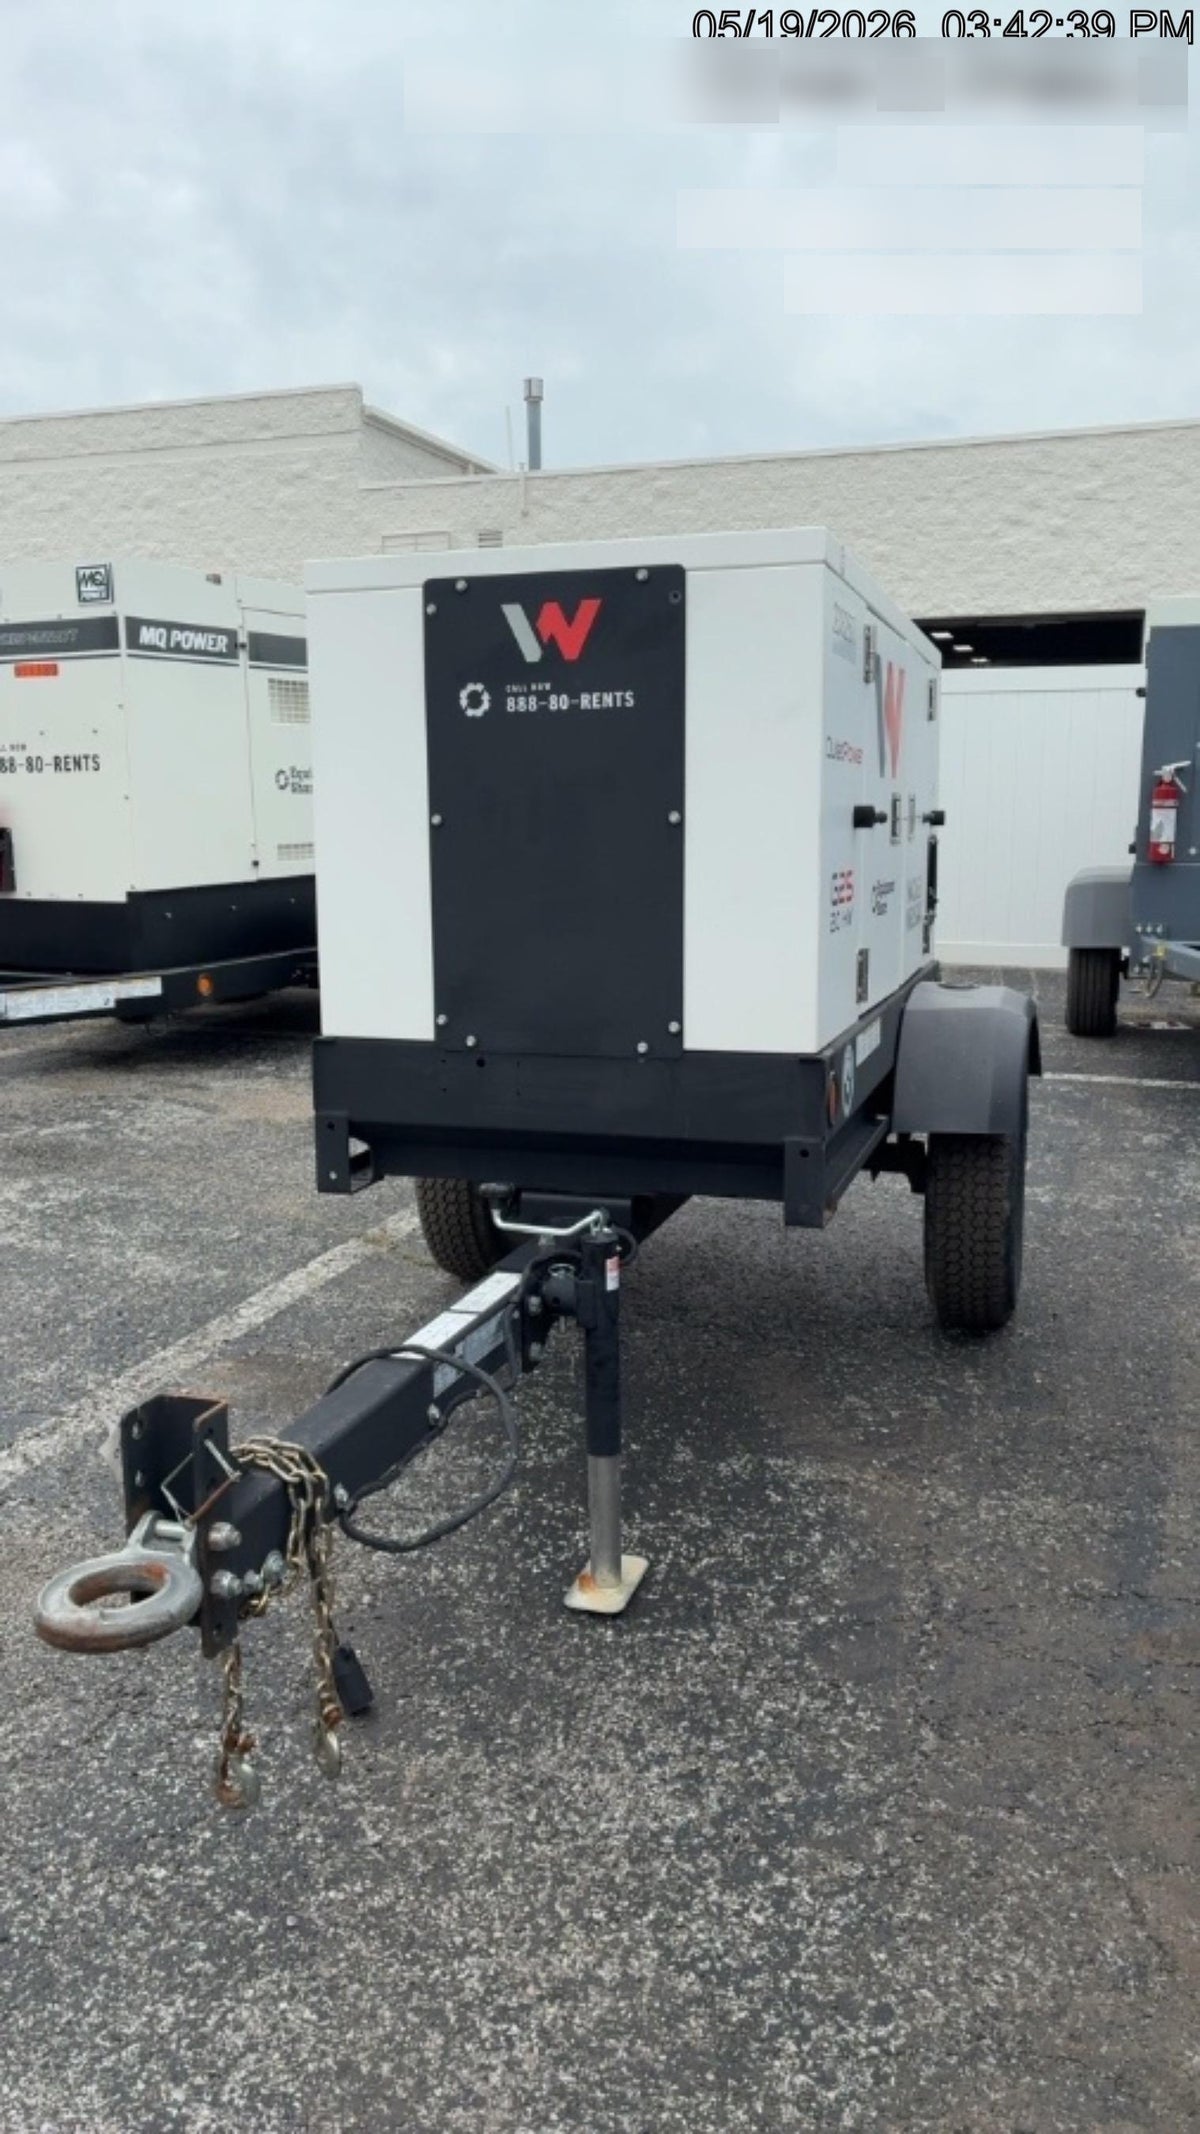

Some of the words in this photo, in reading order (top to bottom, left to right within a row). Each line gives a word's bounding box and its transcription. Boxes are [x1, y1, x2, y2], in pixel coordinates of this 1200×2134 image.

[139, 625, 167, 650] MQ
[170, 630, 228, 653] POWER
[506, 691, 634, 712] 888-80-RENTS
